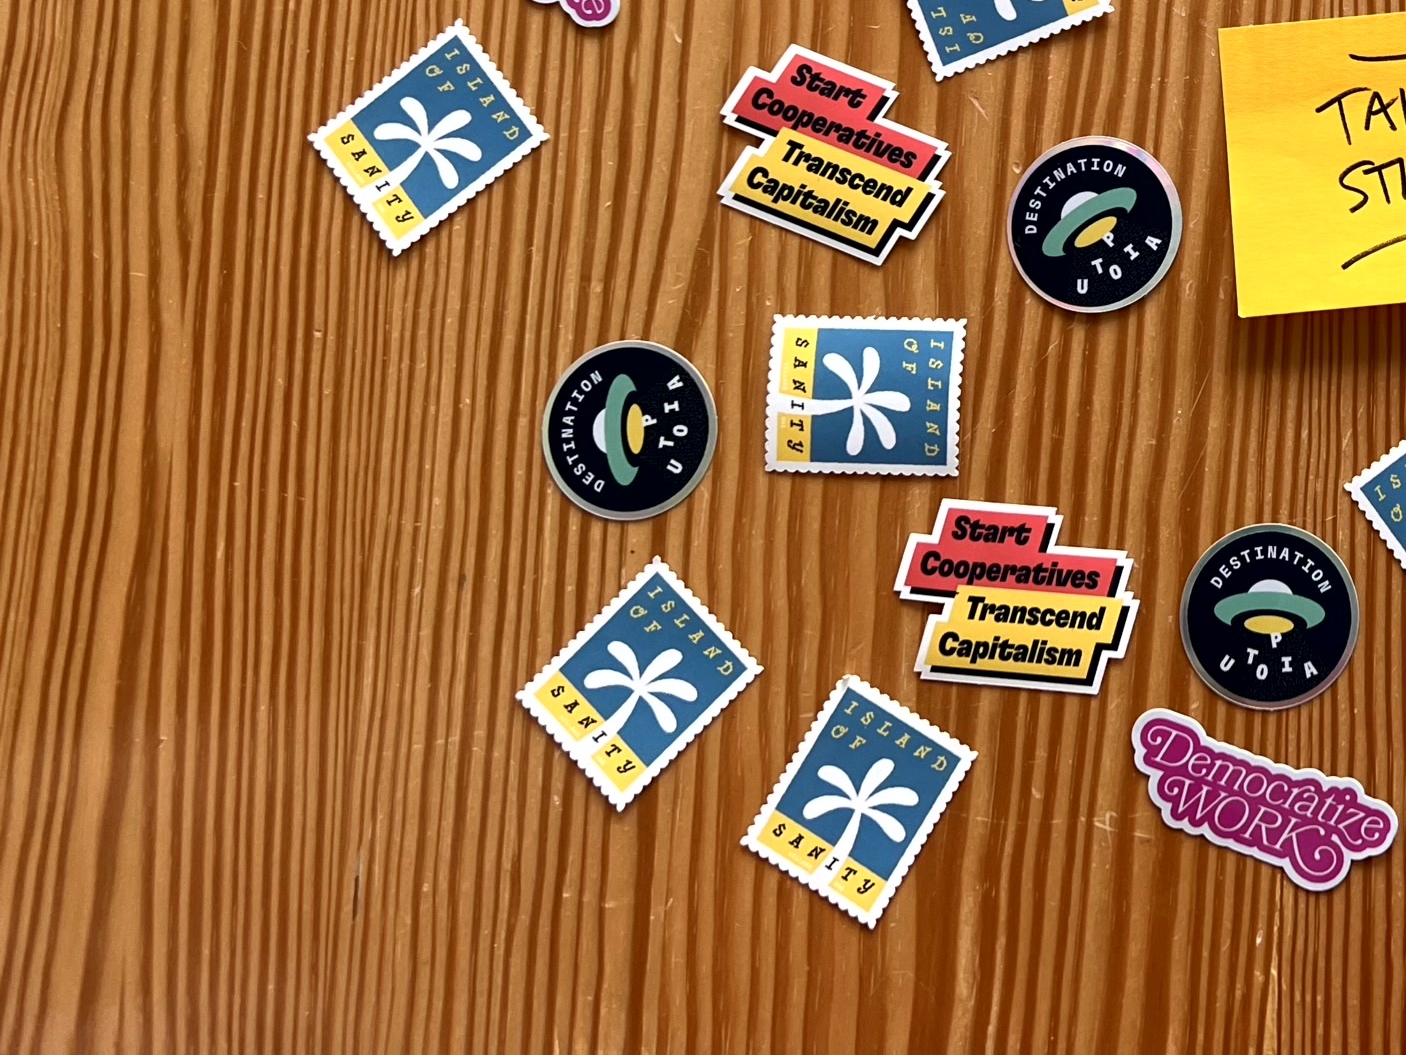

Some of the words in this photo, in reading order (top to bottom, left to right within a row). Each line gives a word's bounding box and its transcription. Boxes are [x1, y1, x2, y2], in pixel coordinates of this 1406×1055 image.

[959, 12, 985, 45] OF
[425, 64, 455, 93] OF
[444, 48, 520, 141] ISLAND
[790, 62, 867, 109] Start
[751, 86, 917, 169] Cooperatives
[340, 133, 415, 223] SANITY
[745, 165, 879, 236] Capitalism
[781, 138, 914, 208] Transcend
[1024, 157, 1127, 234] DESTINATION
[1076, 229, 1162, 295] UTOPIA
[902, 337, 919, 375] OF
[640, 374, 689, 475] UTOPIA
[786, 336, 810, 453] SANITY
[923, 338, 945, 457] ISLAND
[560, 369, 605, 493] DESTINATION
[951, 514, 1032, 546] Start
[919, 550, 1101, 590] Cooperatives
[1210, 545, 1332, 593] DESTINATION
[629, 604, 662, 633] OF
[647, 585, 734, 676] ISLAND
[967, 594, 1107, 631] Transcend
[938, 630, 1083, 667] Capitalism
[1219, 631, 1319, 681] UTOPIA
[550, 684, 636, 774] SANITY
[830, 724, 867, 750] OF
[844, 700, 948, 772] ISLAND
[1146, 725, 1385, 845] Democratize
[772, 823, 876, 895] SANITY
[1163, 776, 1338, 877] WORK
